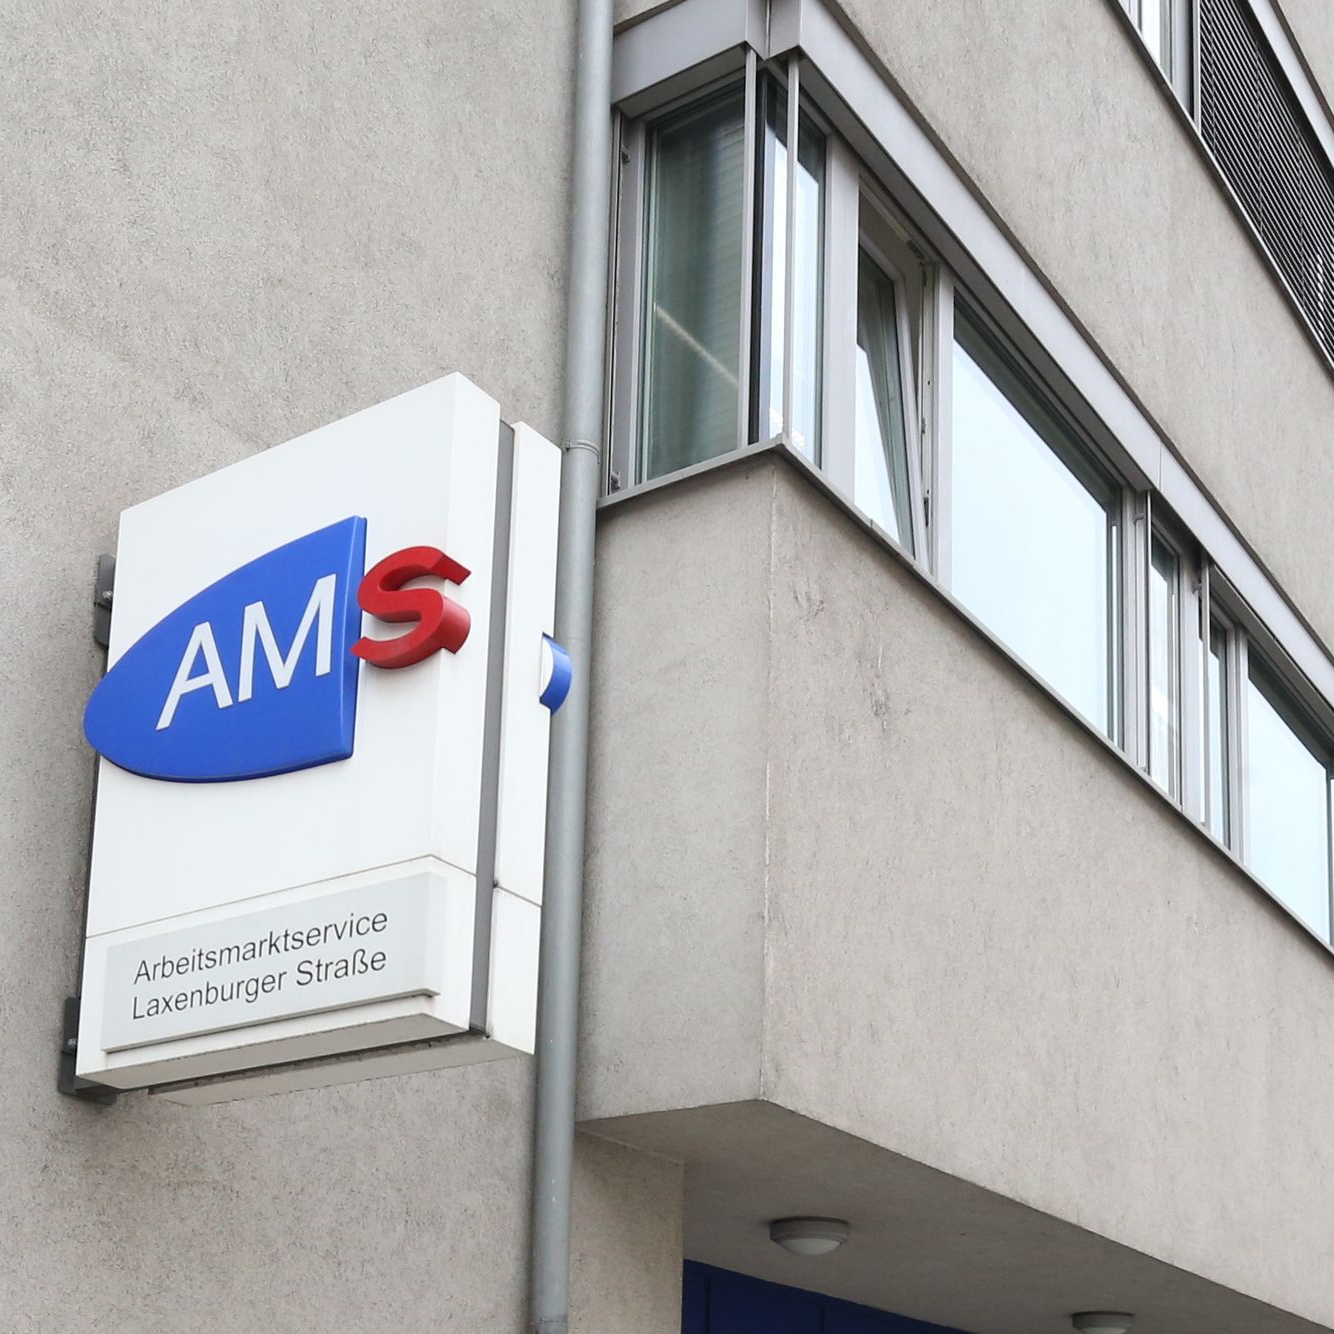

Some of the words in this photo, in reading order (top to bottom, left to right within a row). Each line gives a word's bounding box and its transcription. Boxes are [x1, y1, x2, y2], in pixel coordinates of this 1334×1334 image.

[155, 545, 471, 731] AMS
[132, 971, 286, 1020] Laxenburger
[295, 947, 387, 988] Straße
[133, 910, 389, 985] Arbeitsmarktservice
